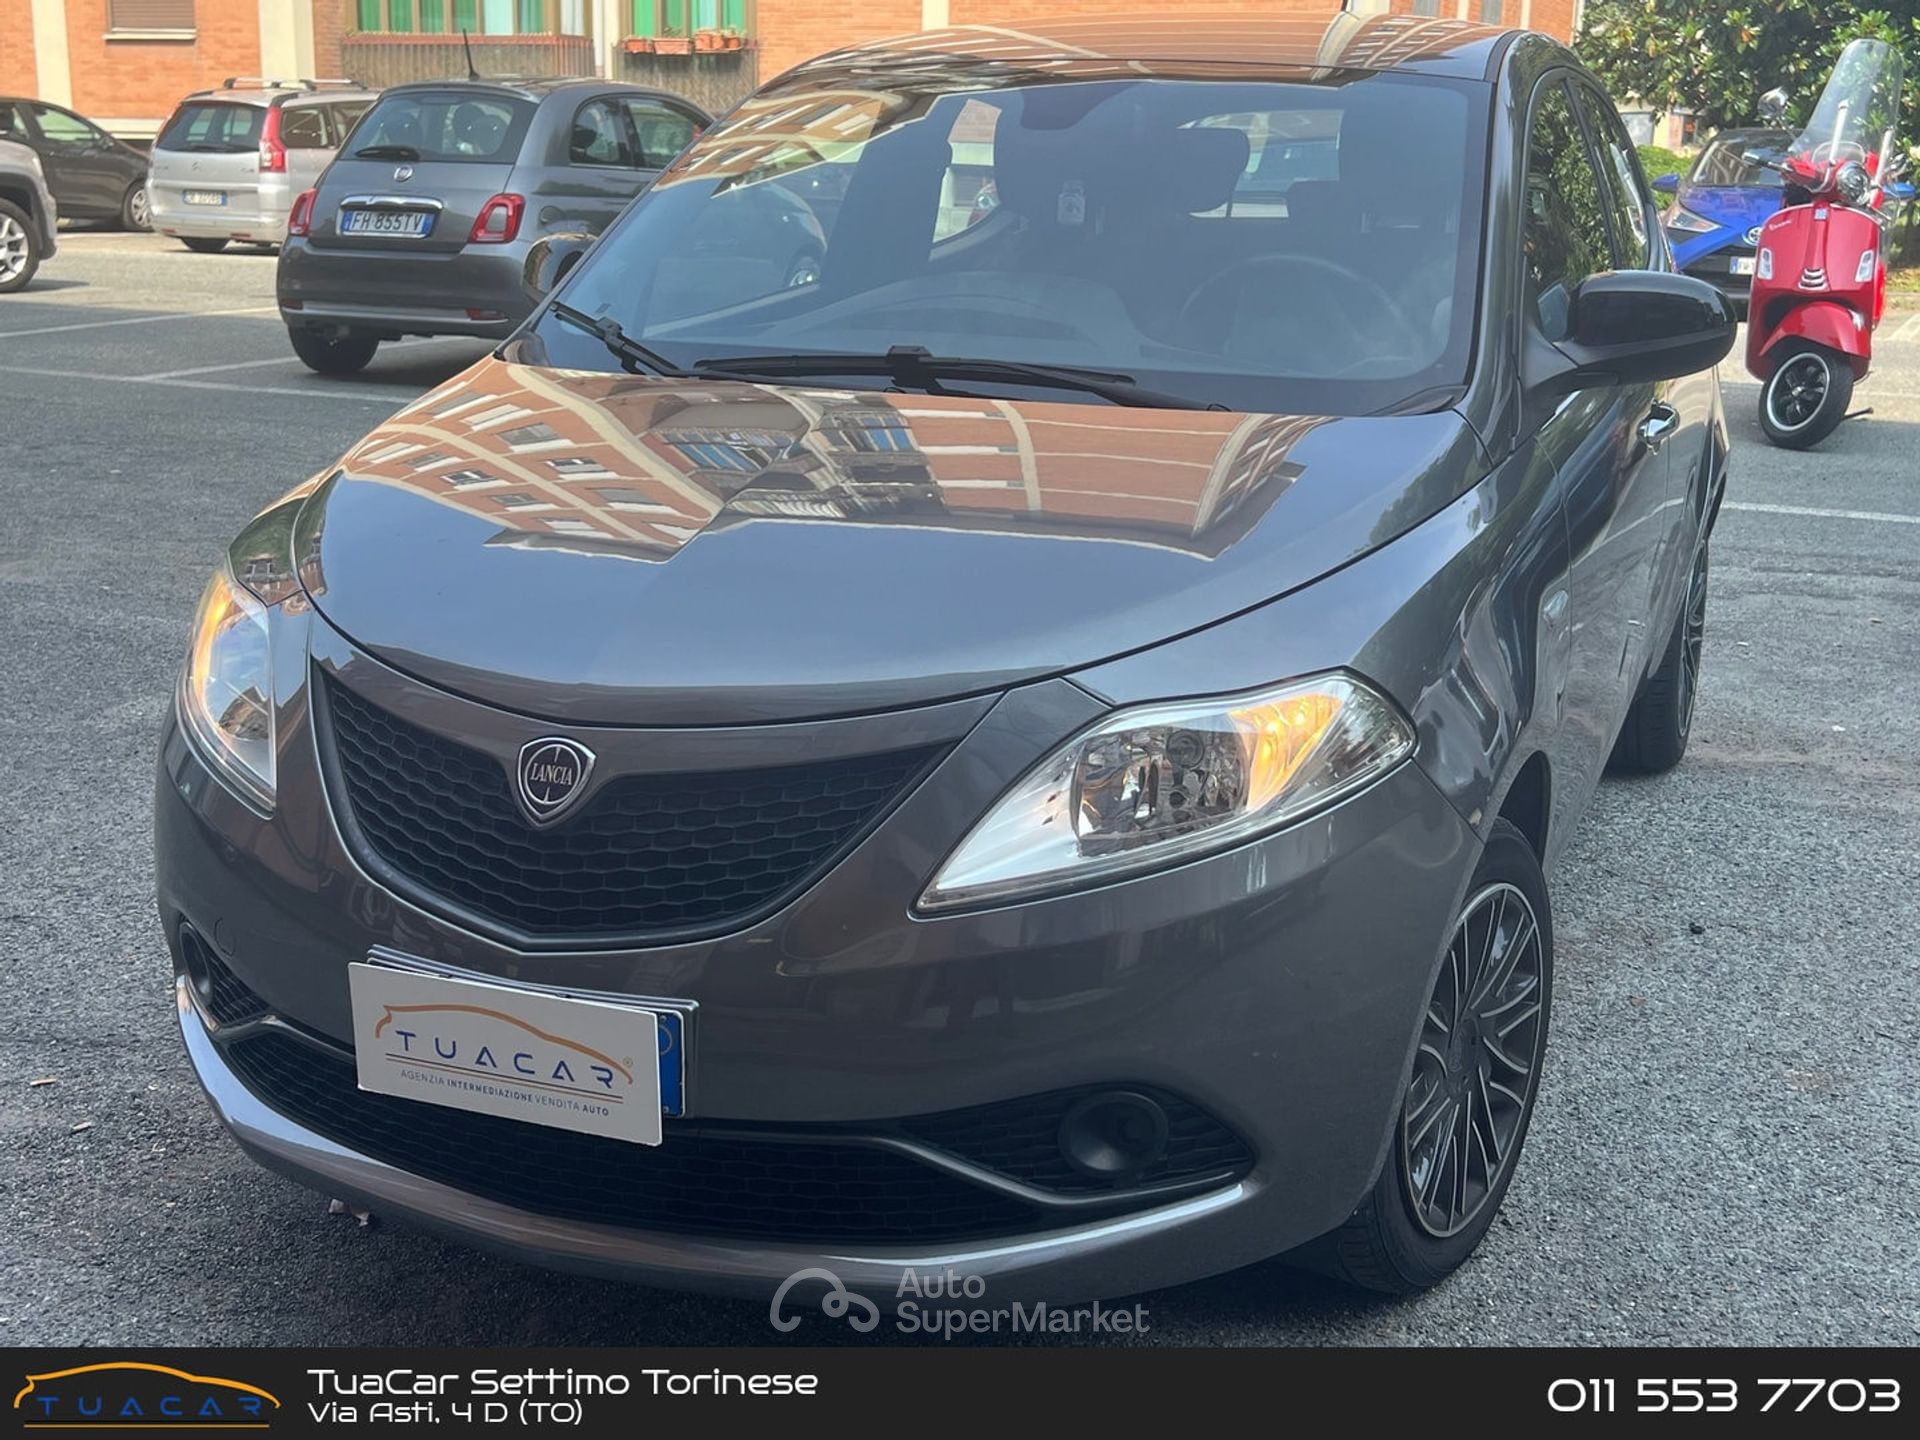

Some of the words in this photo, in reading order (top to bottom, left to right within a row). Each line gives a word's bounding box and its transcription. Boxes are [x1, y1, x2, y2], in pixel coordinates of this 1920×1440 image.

[352, 211, 372, 229] FH
[529, 762, 573, 786] LANCIA
[396, 1030, 614, 1089] TUACAR
[400, 1068, 445, 1086] AGENZIA
[447, 1079, 534, 1103] INTERMEDIAZIONE
[533, 1094, 581, 1112] VENDITA
[582, 1104, 610, 1117] AUTO
